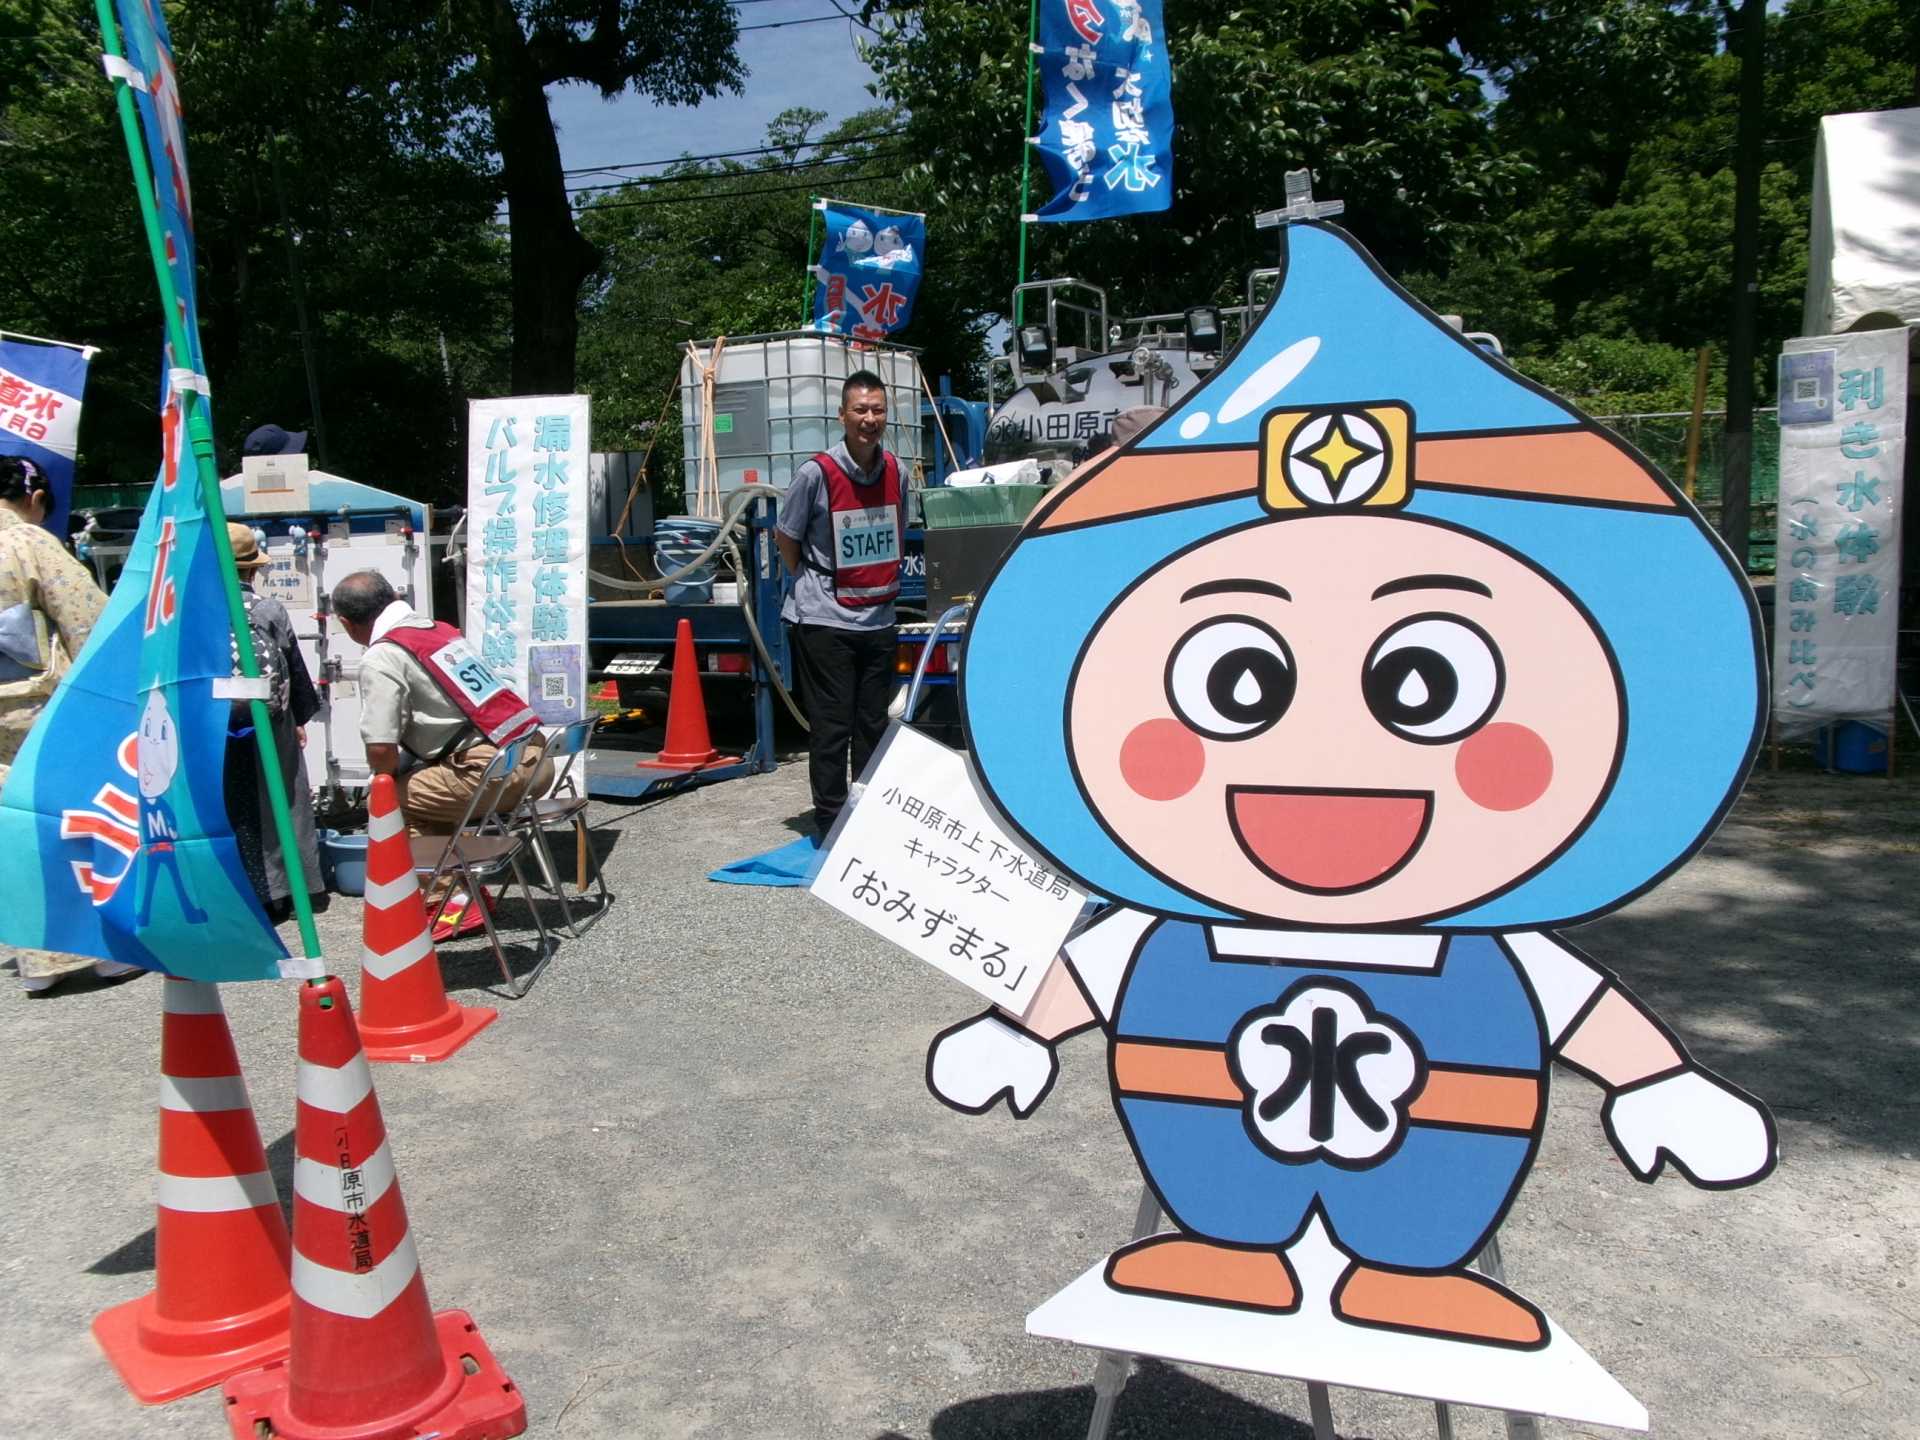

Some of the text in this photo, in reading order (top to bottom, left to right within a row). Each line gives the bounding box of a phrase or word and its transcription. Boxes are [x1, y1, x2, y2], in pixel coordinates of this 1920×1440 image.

[482, 416, 518, 669] バルブ操作体験
[532, 414, 571, 642] 漏水修理体験
[842, 530, 893, 558] STAFF
[1834, 367, 1884, 615] 利き水体験
[882, 786, 1072, 901] 小田原市上下水道局
[904, 837, 1011, 903] キャラクター
[840, 857, 1028, 992] 「おみずまる」
[1258, 1006, 1392, 1142] 水
